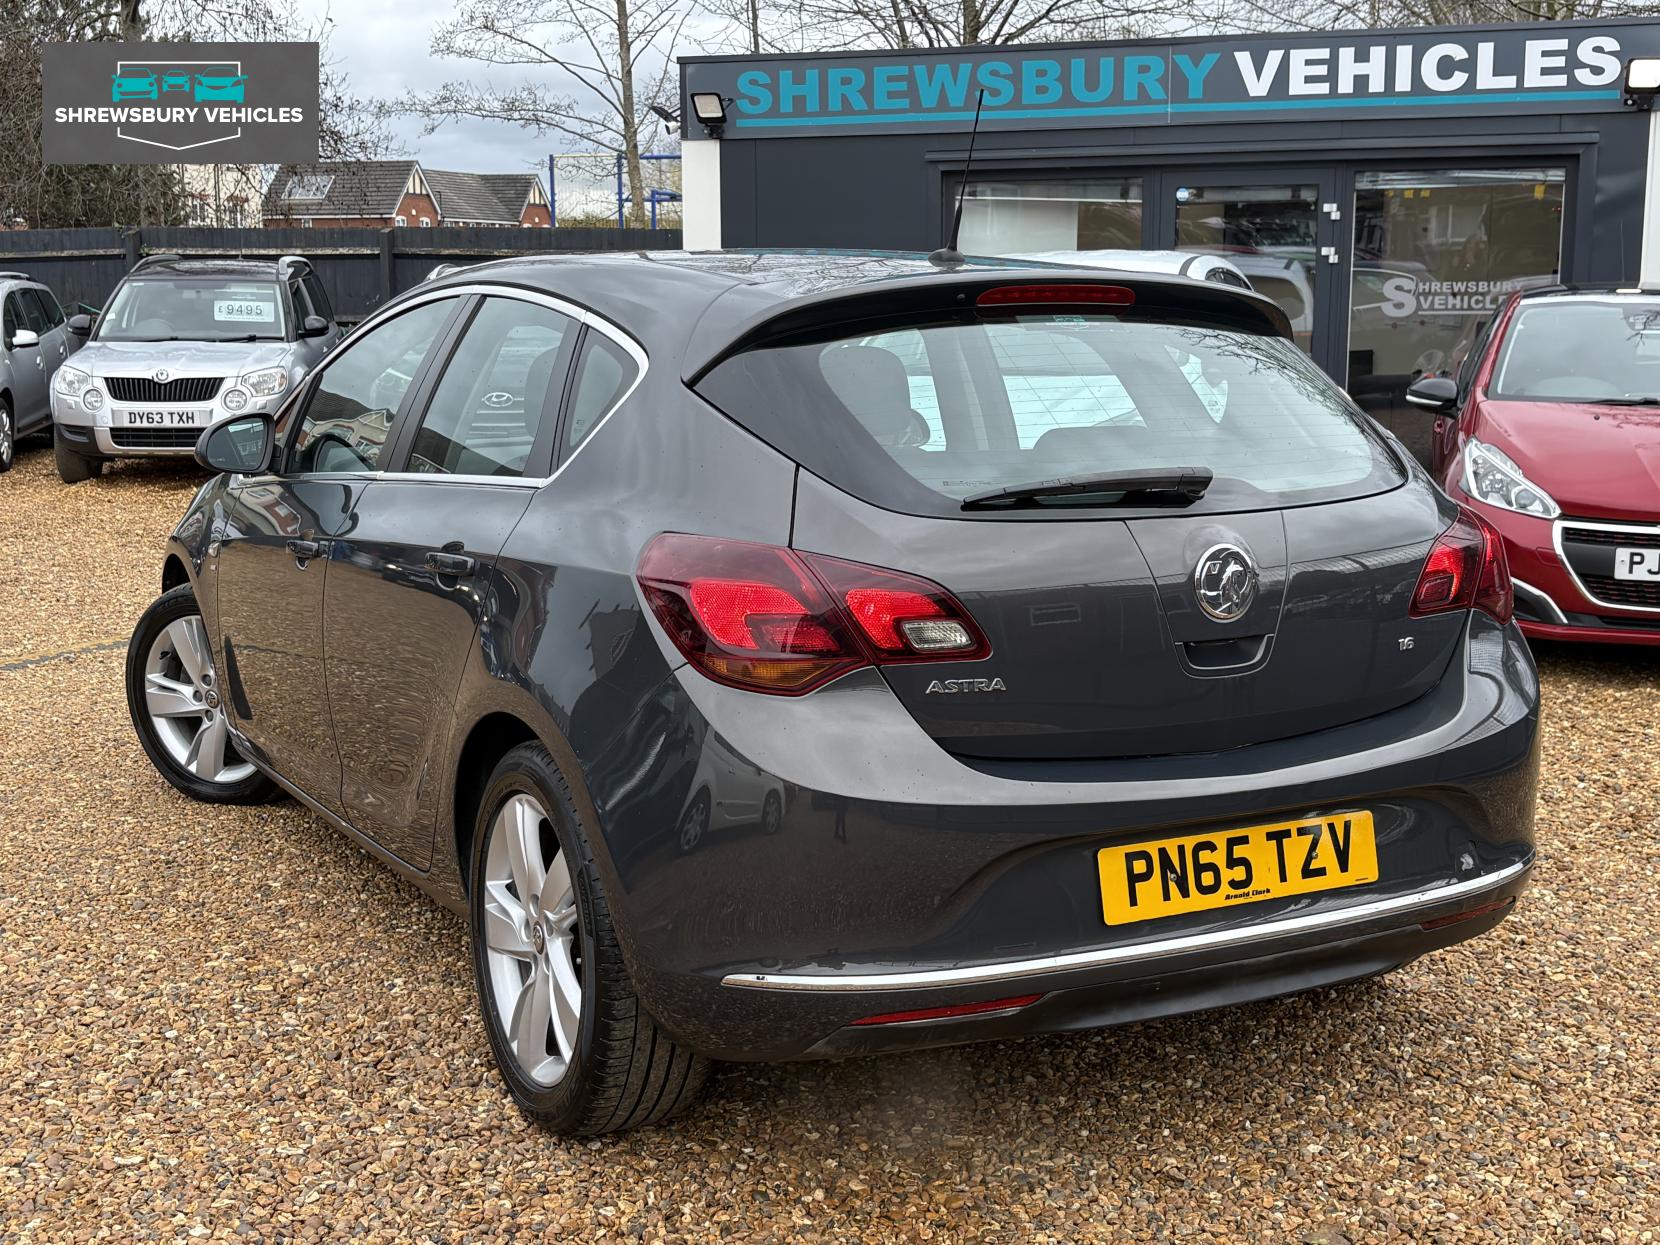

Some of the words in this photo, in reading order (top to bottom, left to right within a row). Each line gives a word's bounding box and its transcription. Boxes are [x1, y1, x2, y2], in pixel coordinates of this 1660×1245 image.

[736, 53, 1221, 115] SHREWSBURY
[1234, 36, 1621, 97] VEHICLES
[128, 411, 164, 424] DY63
[168, 411, 195, 424] TXH
[925, 677, 1007, 694] ASTRA
[1124, 834, 1254, 907] PN65
[1265, 819, 1352, 883] TZV
[1225, 890, 1251, 901] Arnold
[1252, 887, 1271, 896] Clark
